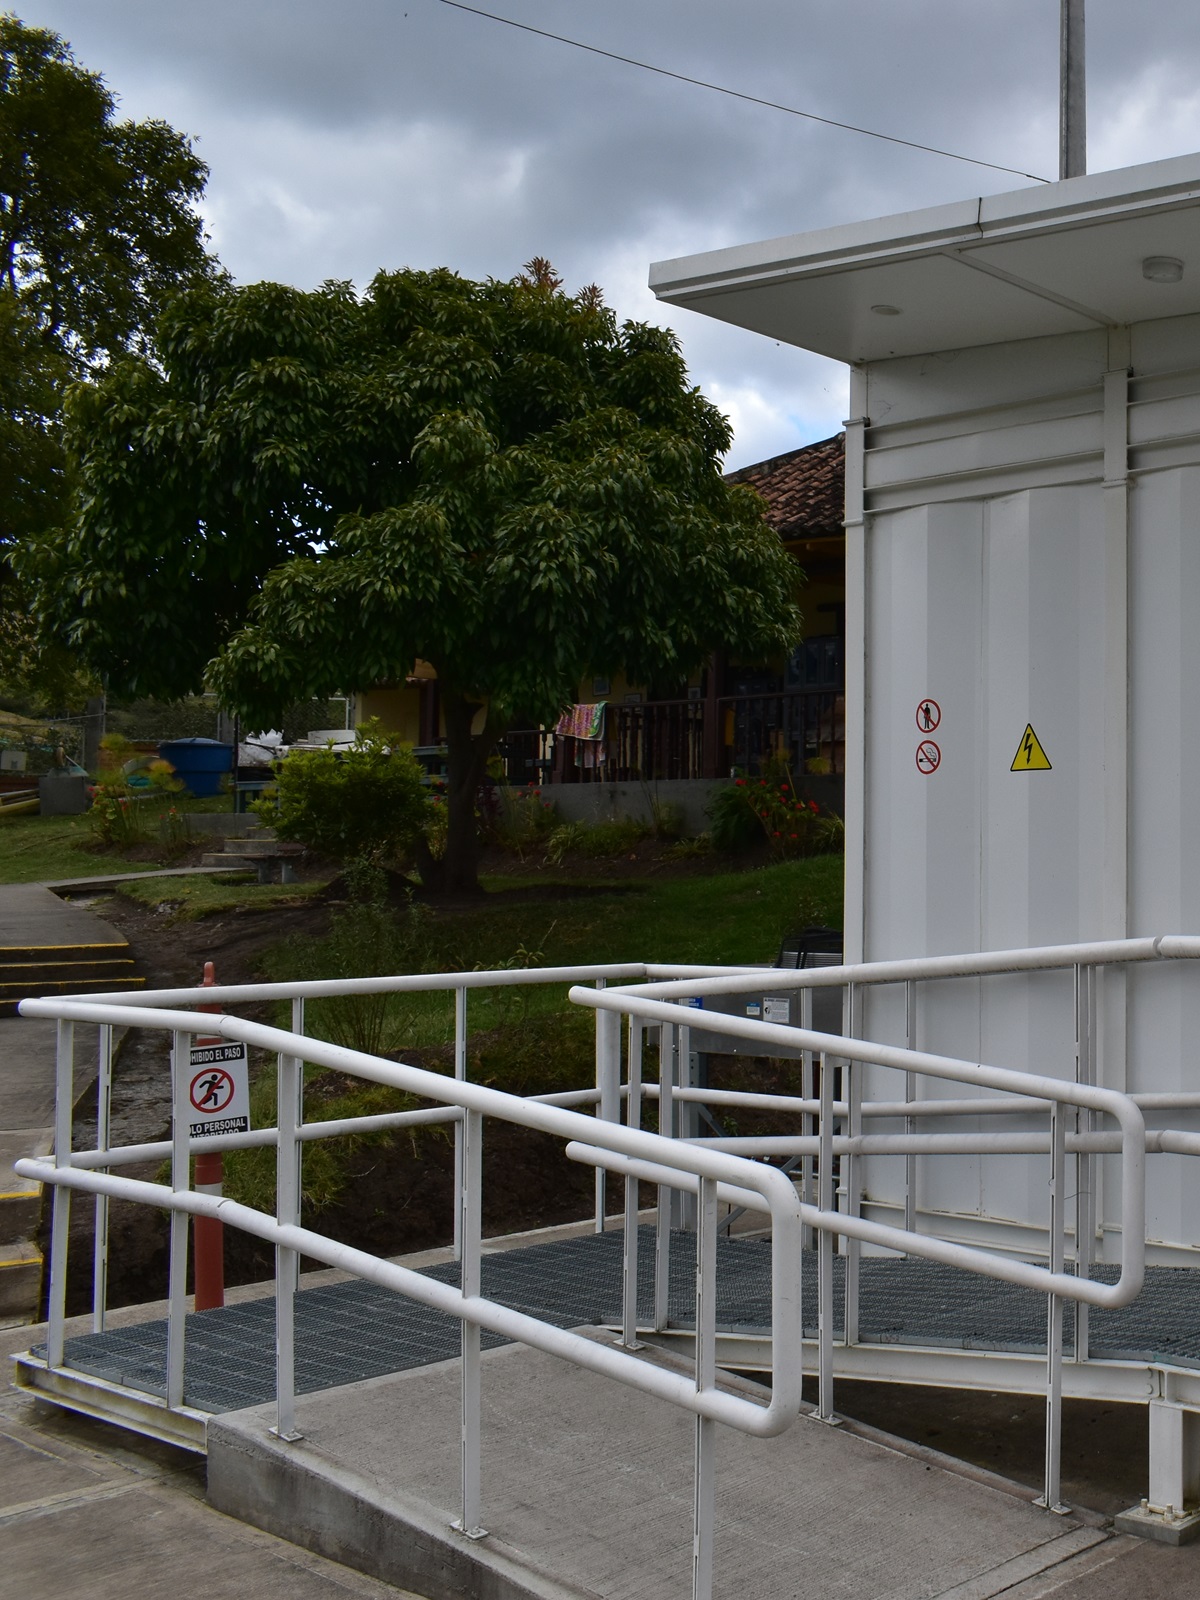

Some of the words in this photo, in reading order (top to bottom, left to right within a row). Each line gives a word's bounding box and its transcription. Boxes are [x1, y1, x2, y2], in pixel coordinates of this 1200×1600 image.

[191, 1050, 214, 1063] HIBIDO
[216, 1050, 223, 1060] EL
[225, 1047, 241, 1058] PASO
[190, 1125, 202, 1134] LO
[204, 1118, 245, 1132] PERSONAL
